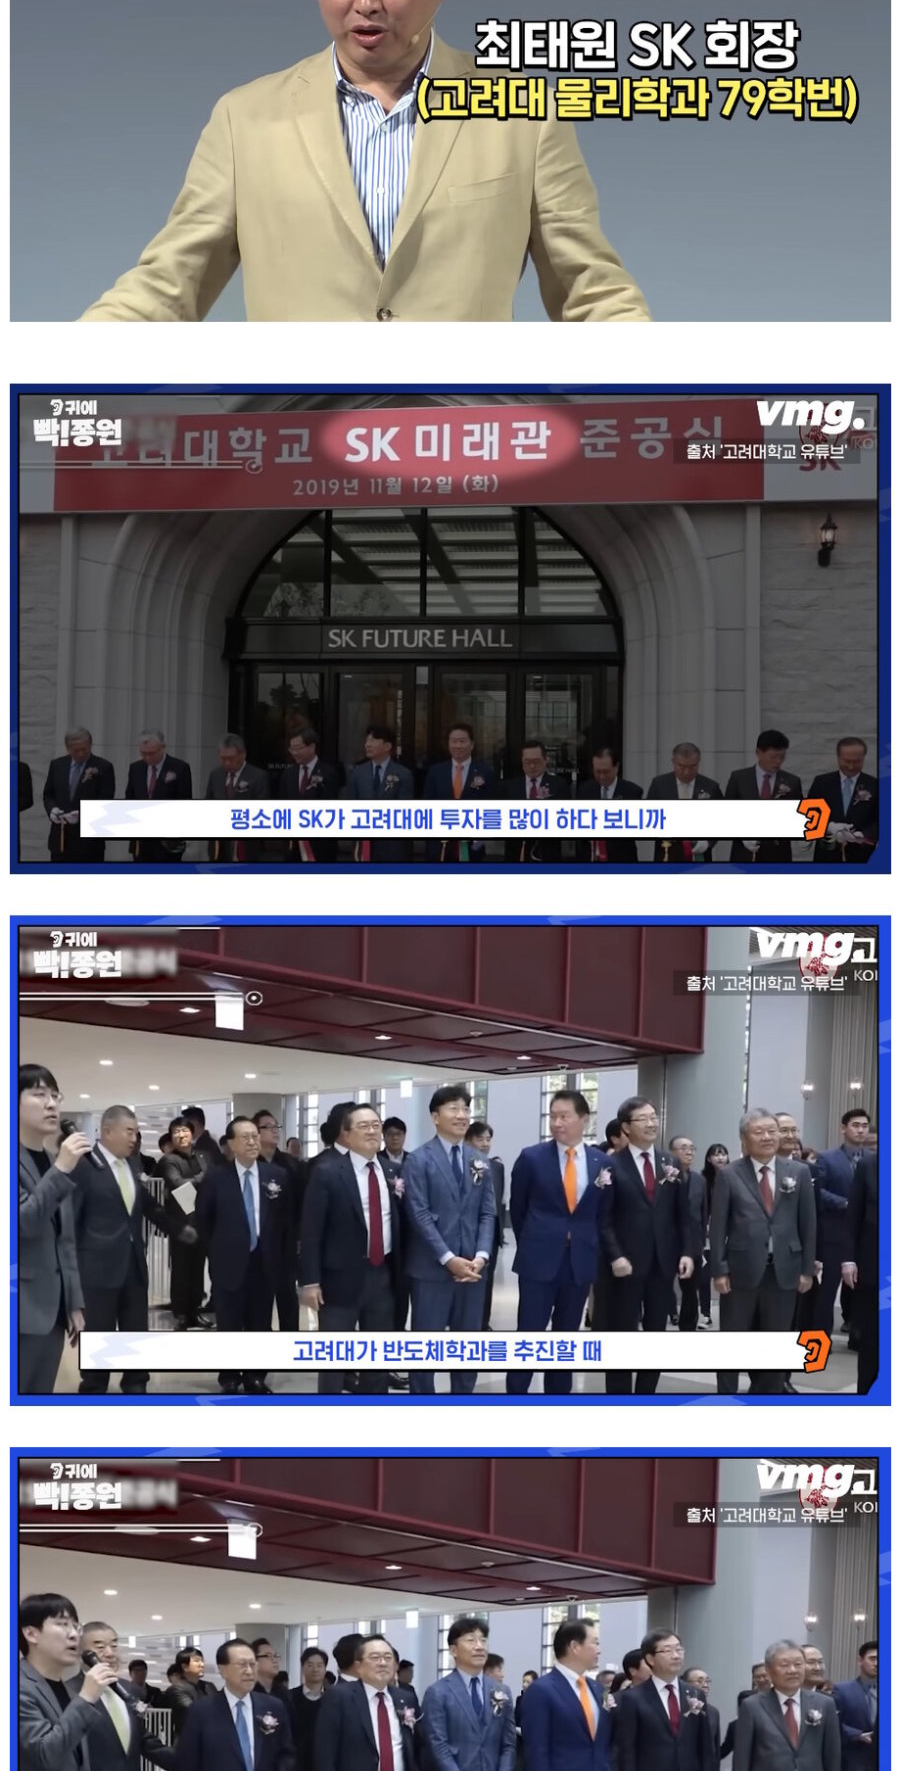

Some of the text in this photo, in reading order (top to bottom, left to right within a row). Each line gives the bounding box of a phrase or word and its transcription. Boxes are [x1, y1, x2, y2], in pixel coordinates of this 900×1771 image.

[344, 426, 401, 463] SK
[415, 420, 552, 462] 미래관
[293, 473, 499, 495] 2019년 11월 12일 (화)
[328, 629, 513, 648] SK FUTURE HALL
